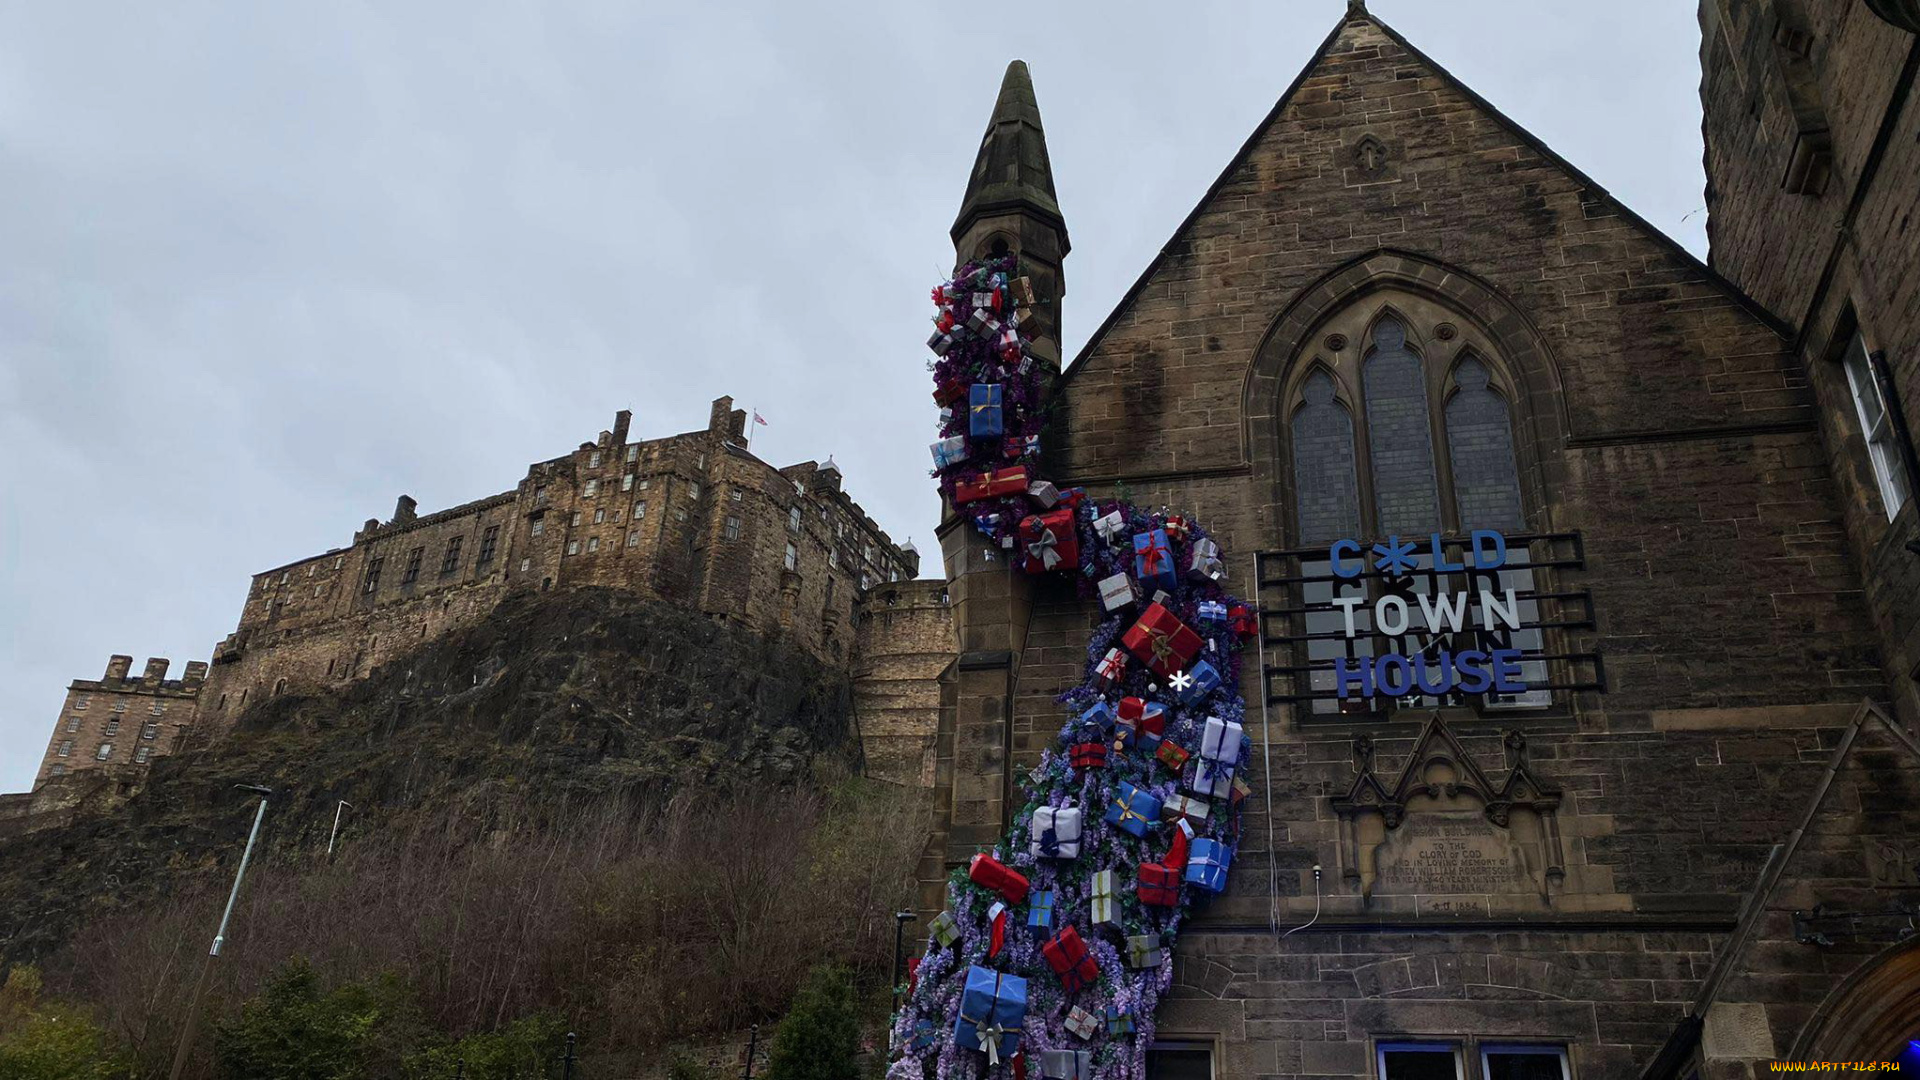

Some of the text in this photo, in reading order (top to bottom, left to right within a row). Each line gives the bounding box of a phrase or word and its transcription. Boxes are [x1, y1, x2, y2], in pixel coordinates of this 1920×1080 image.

[1331, 588, 1521, 638] TOWN
[1334, 648, 1527, 699] HOUSE
[1444, 826, 1494, 837] BUILDINGS
[1432, 842, 1466, 851] TO THE
[1413, 859, 1423, 867] IN
[1461, 858, 1496, 867] MEMORY
[1500, 857, 1510, 866] OF
[1418, 866, 1457, 876] WILLIAM
